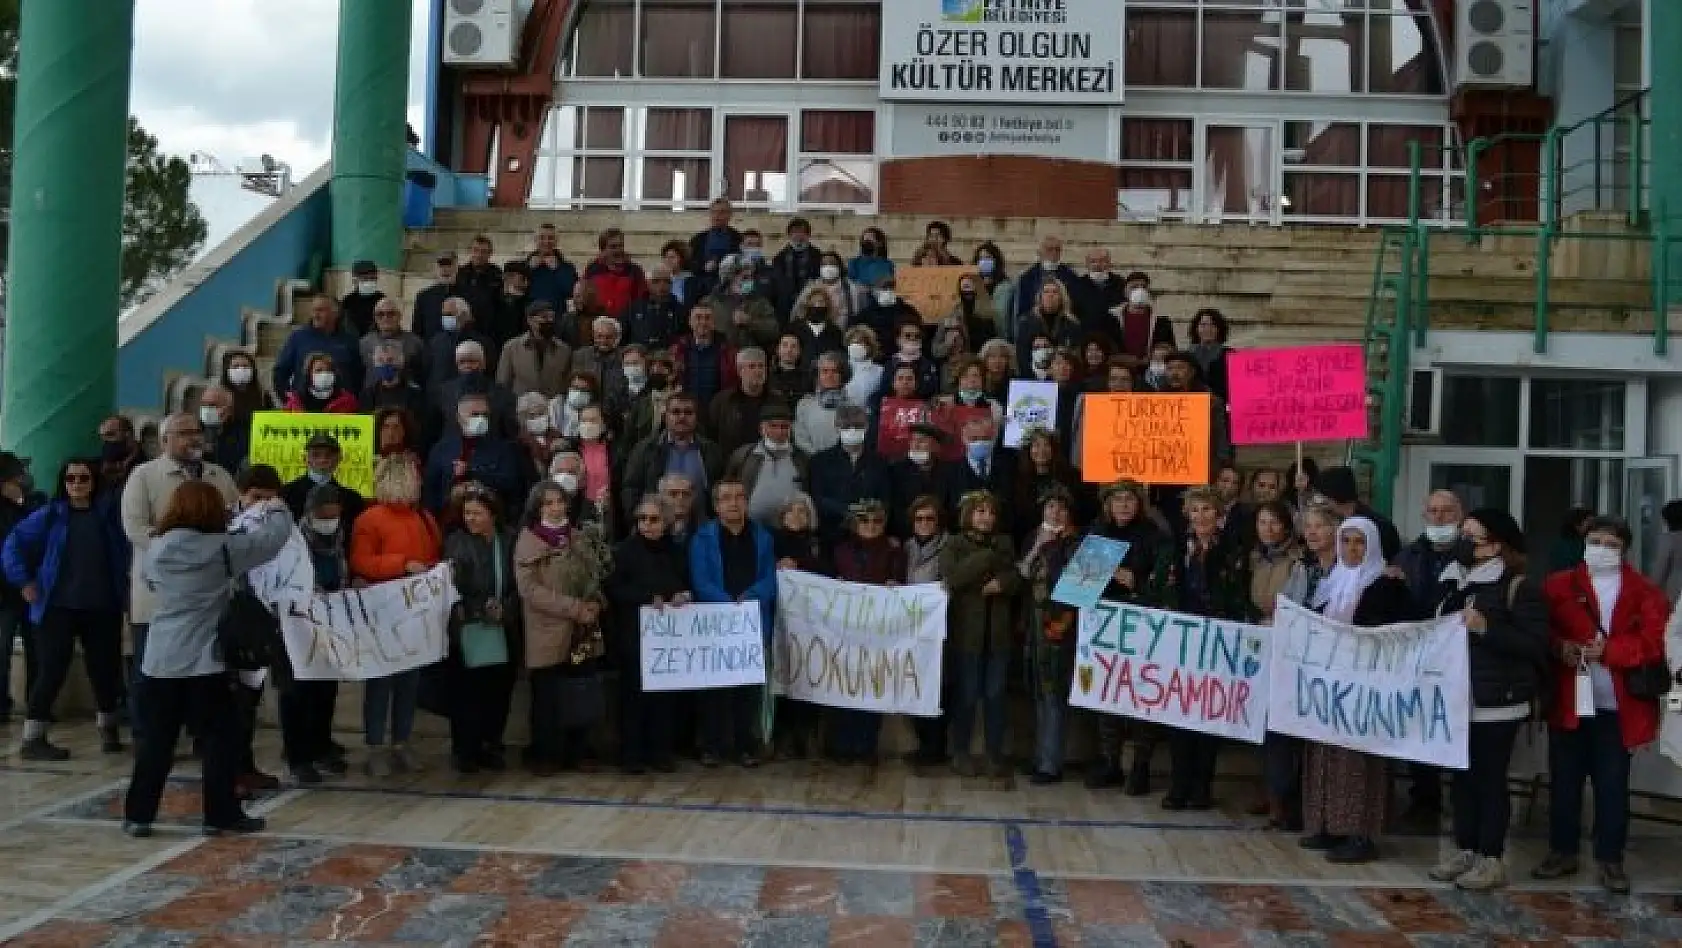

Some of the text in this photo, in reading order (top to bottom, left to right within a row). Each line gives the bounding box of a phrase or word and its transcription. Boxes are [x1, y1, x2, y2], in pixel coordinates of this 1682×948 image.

[891, 58, 1114, 93] KÜLTÜR MERKEZİ
[916, 23, 1091, 58] ÖZER OLGUN
[691, 611, 758, 637] MADEN
[1090, 604, 1243, 679] ZEYTİN
[782, 632, 921, 703] DOKUNMA
[1094, 650, 1252, 727] YAŞAMDIR
[1297, 667, 1453, 745] DOKUNMA
